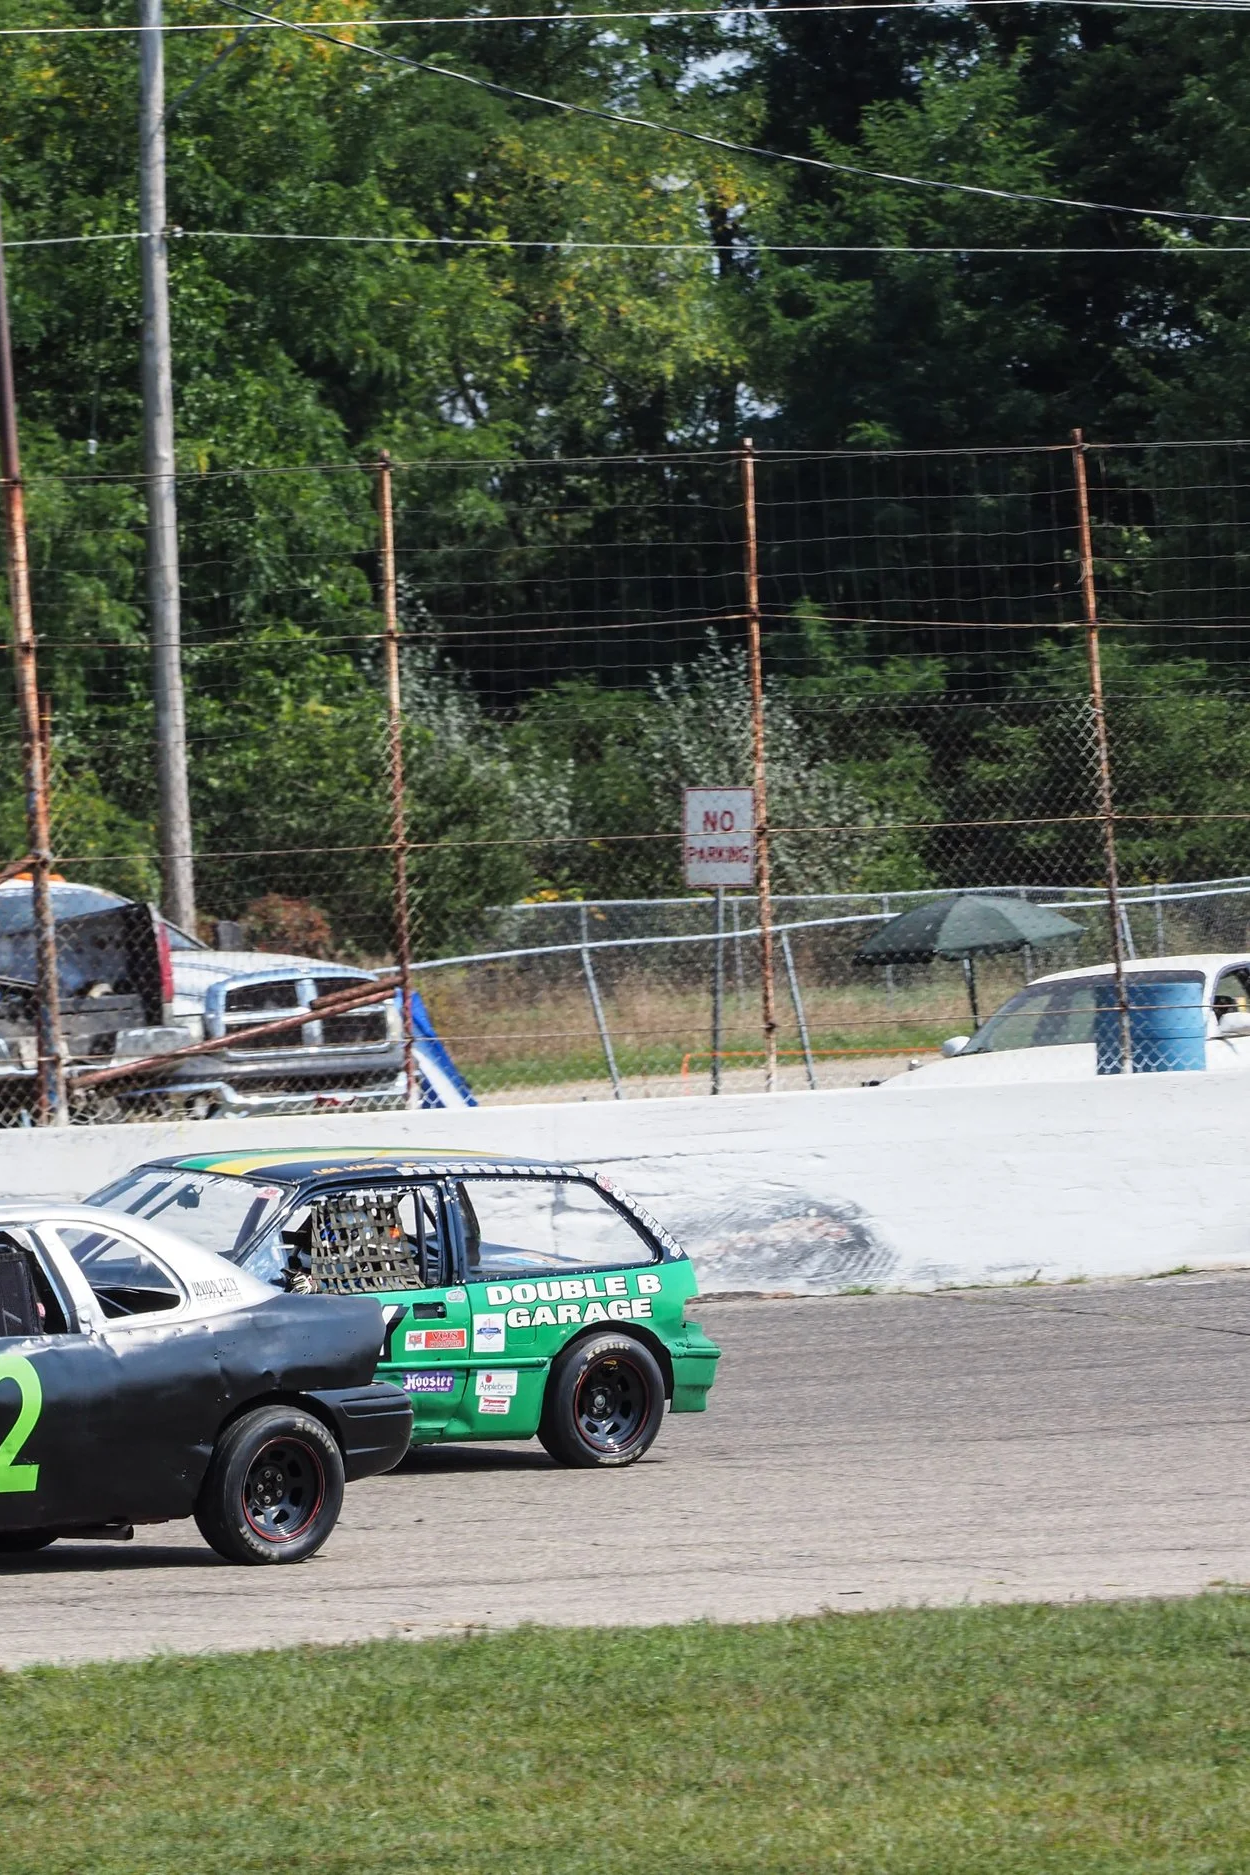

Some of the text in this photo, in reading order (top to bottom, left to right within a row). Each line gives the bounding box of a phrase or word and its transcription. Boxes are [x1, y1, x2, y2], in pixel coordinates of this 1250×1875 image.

[702, 810, 735, 832] NO
[485, 1273, 662, 1306] DOUBLE B
[505, 1297, 653, 1329] GARAGE
[403, 1372, 453, 1390] Hoosier
